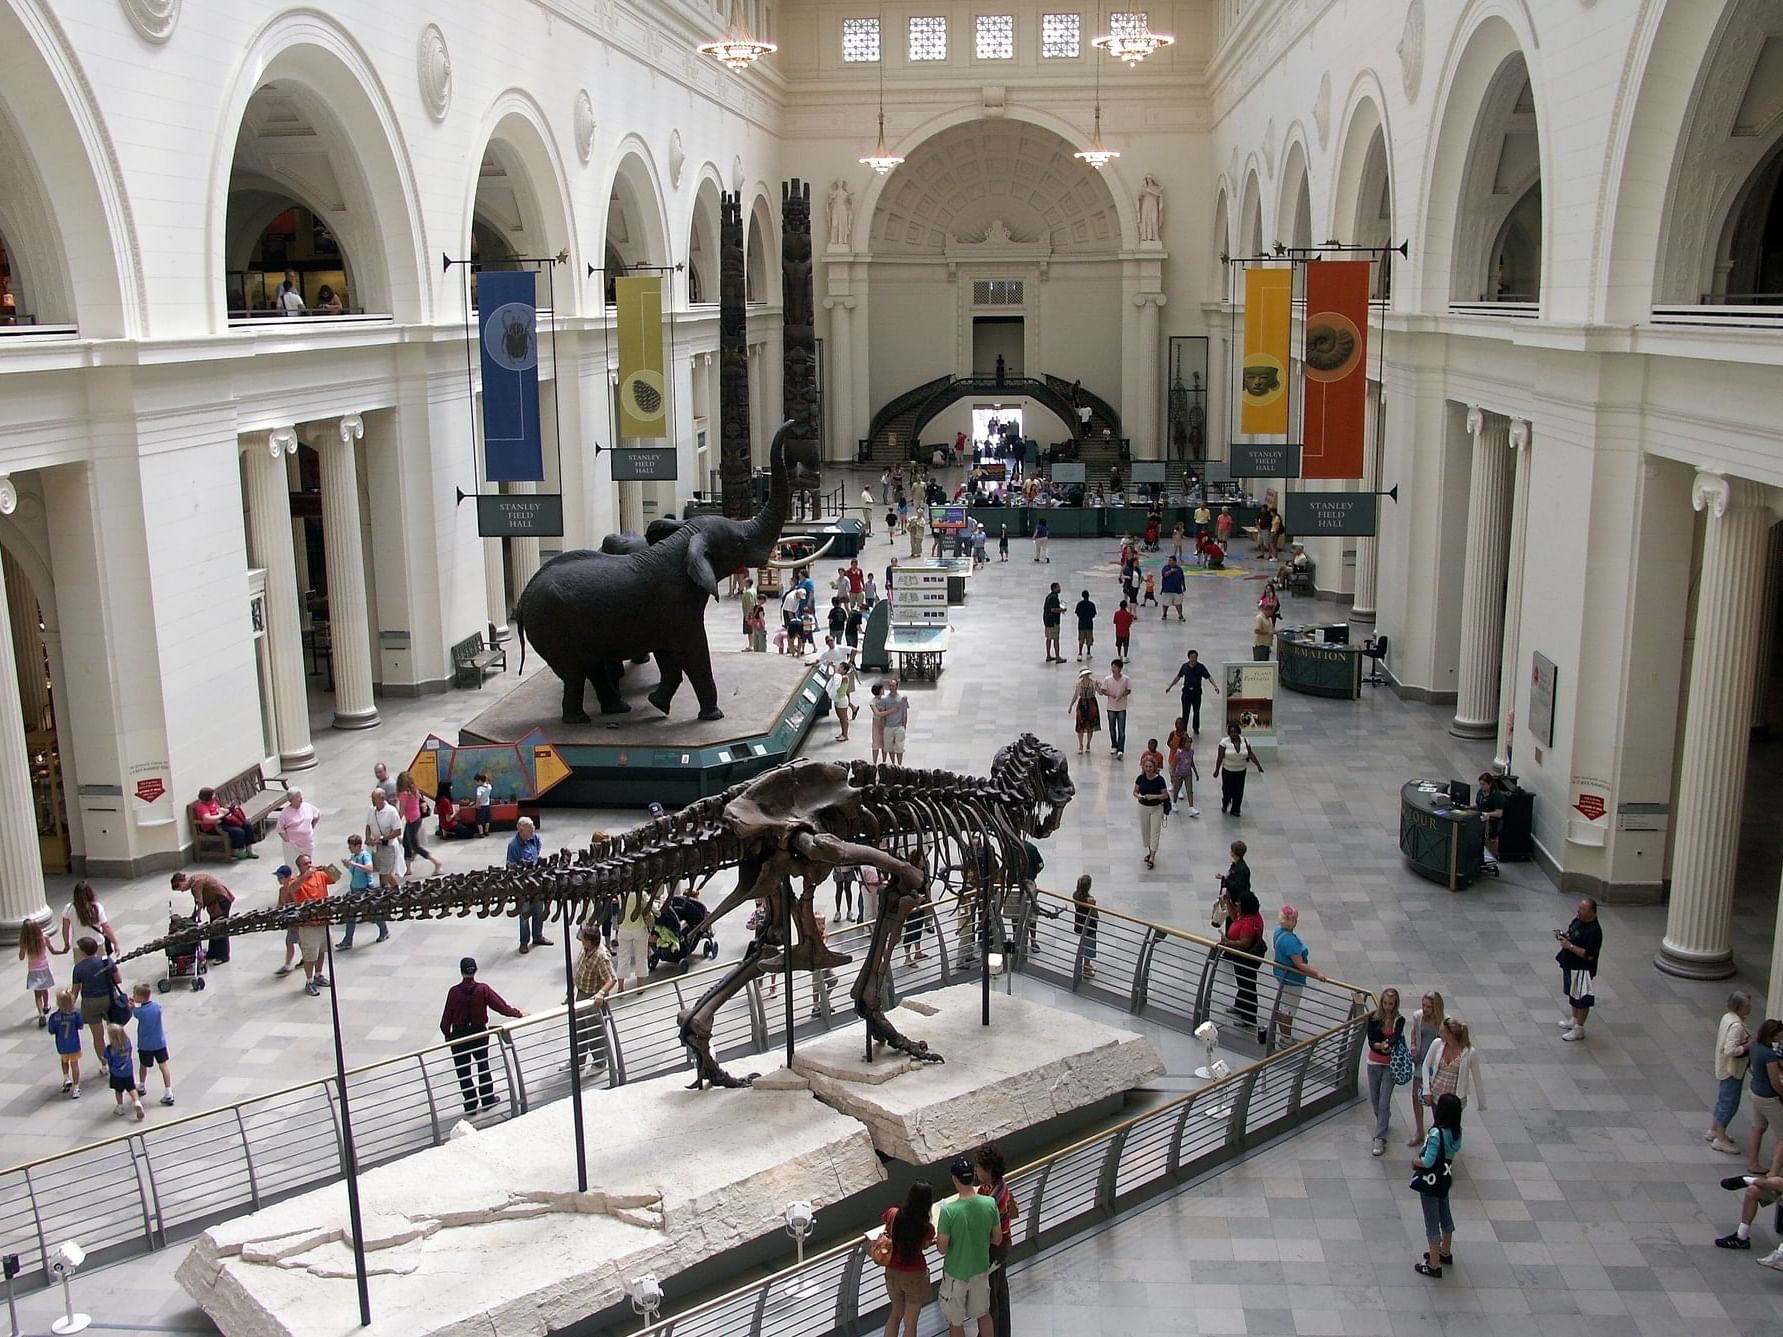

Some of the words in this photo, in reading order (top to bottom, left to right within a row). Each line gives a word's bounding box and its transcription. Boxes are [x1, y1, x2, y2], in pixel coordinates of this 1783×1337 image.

[499, 503, 541, 511] STANLEY
[1309, 502, 1354, 510] STANLEY
[508, 511, 534, 519] FIELD
[509, 520, 534, 528] HALL
[1318, 519, 1344, 527] HALL
[60, 1020, 71, 1040] 7
